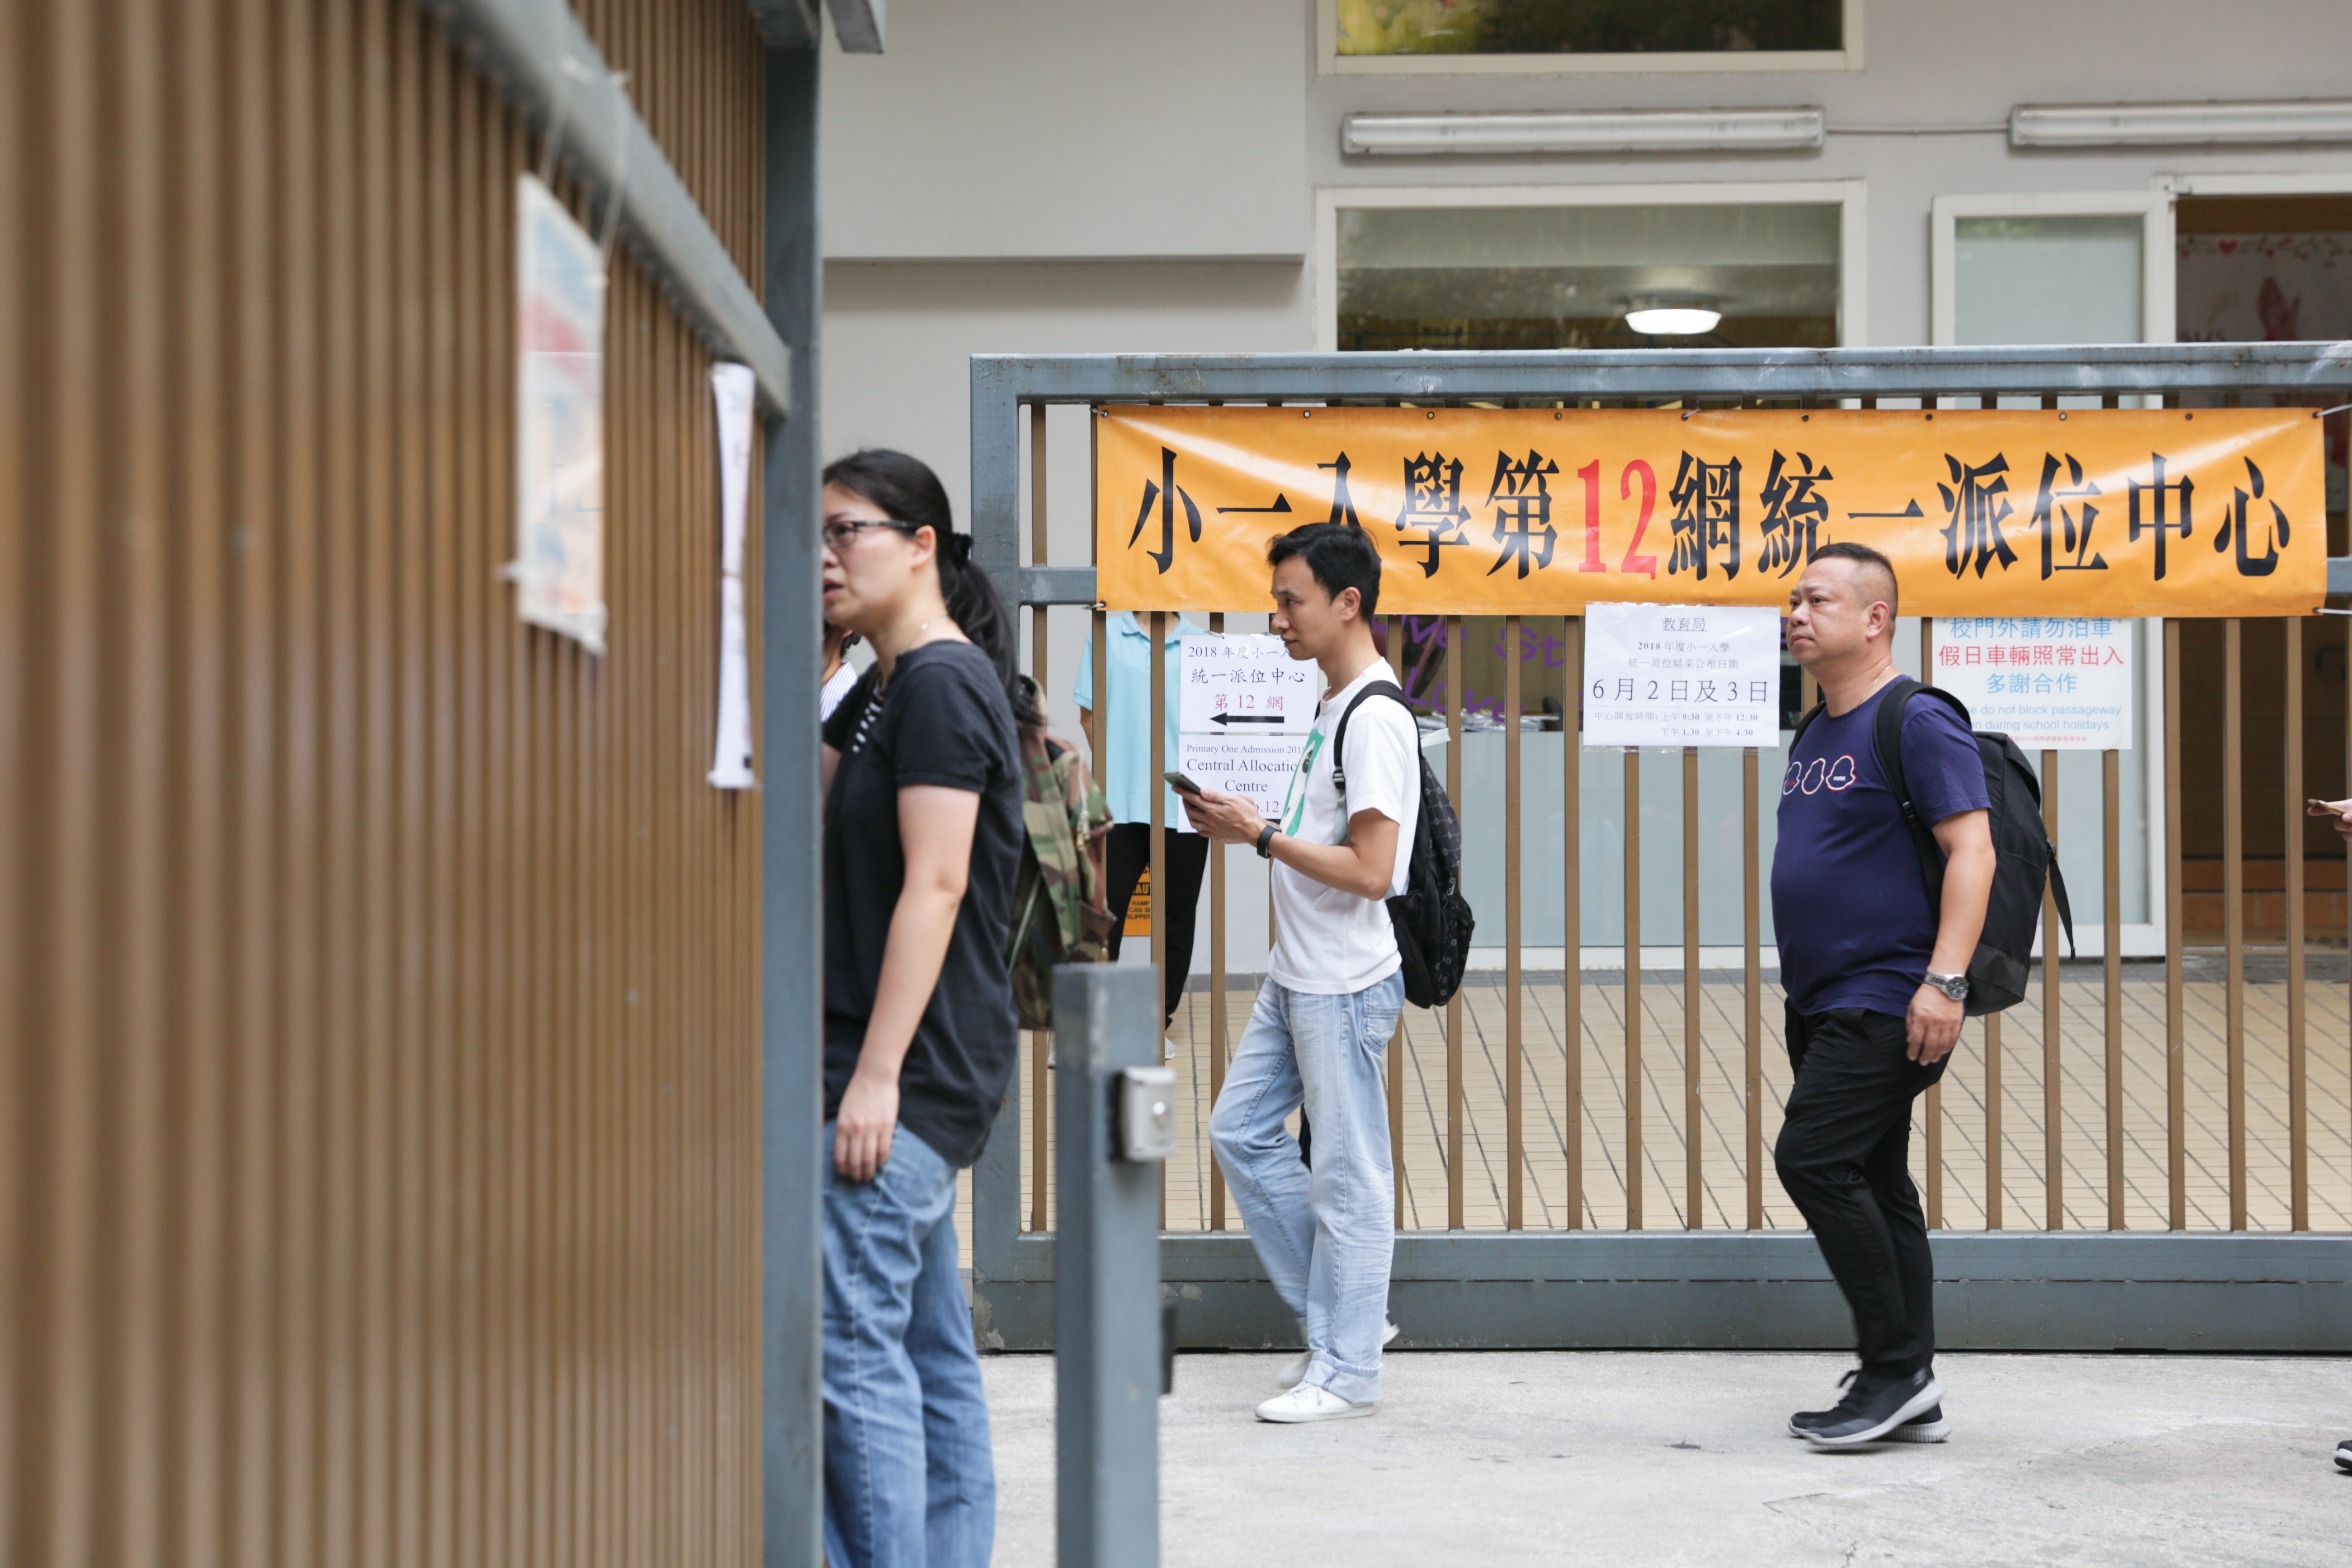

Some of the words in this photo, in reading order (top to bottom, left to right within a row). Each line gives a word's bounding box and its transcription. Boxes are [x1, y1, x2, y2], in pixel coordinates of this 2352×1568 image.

[1662, 617, 1707, 631] 教育局
[1951, 618, 2113, 639] 校門外請勿泊車
[1939, 645, 2124, 666] 假日車輛照常出入
[1628, 658, 1738, 669] 統一派位結果公布日期
[1191, 667, 1305, 685] 統一派位中心
[1987, 673, 2078, 694] 多謝合作
[1981, 706, 1995, 714] do
[1998, 706, 2016, 714] not
[2019, 705, 2048, 715] block
[2052, 707, 2121, 717] passageway
[1985, 721, 2020, 731] during
[2024, 720, 2059, 730] school
[2064, 720, 2109, 731] holidays
[1187, 745, 1219, 754] Primary
[1222, 745, 1239, 753] One
[1241, 746, 1285, 754] Admission
[1187, 759, 1234, 771] Central
[1238, 760, 1297, 772] Allocatio
[1225, 779, 1268, 792] Centre
